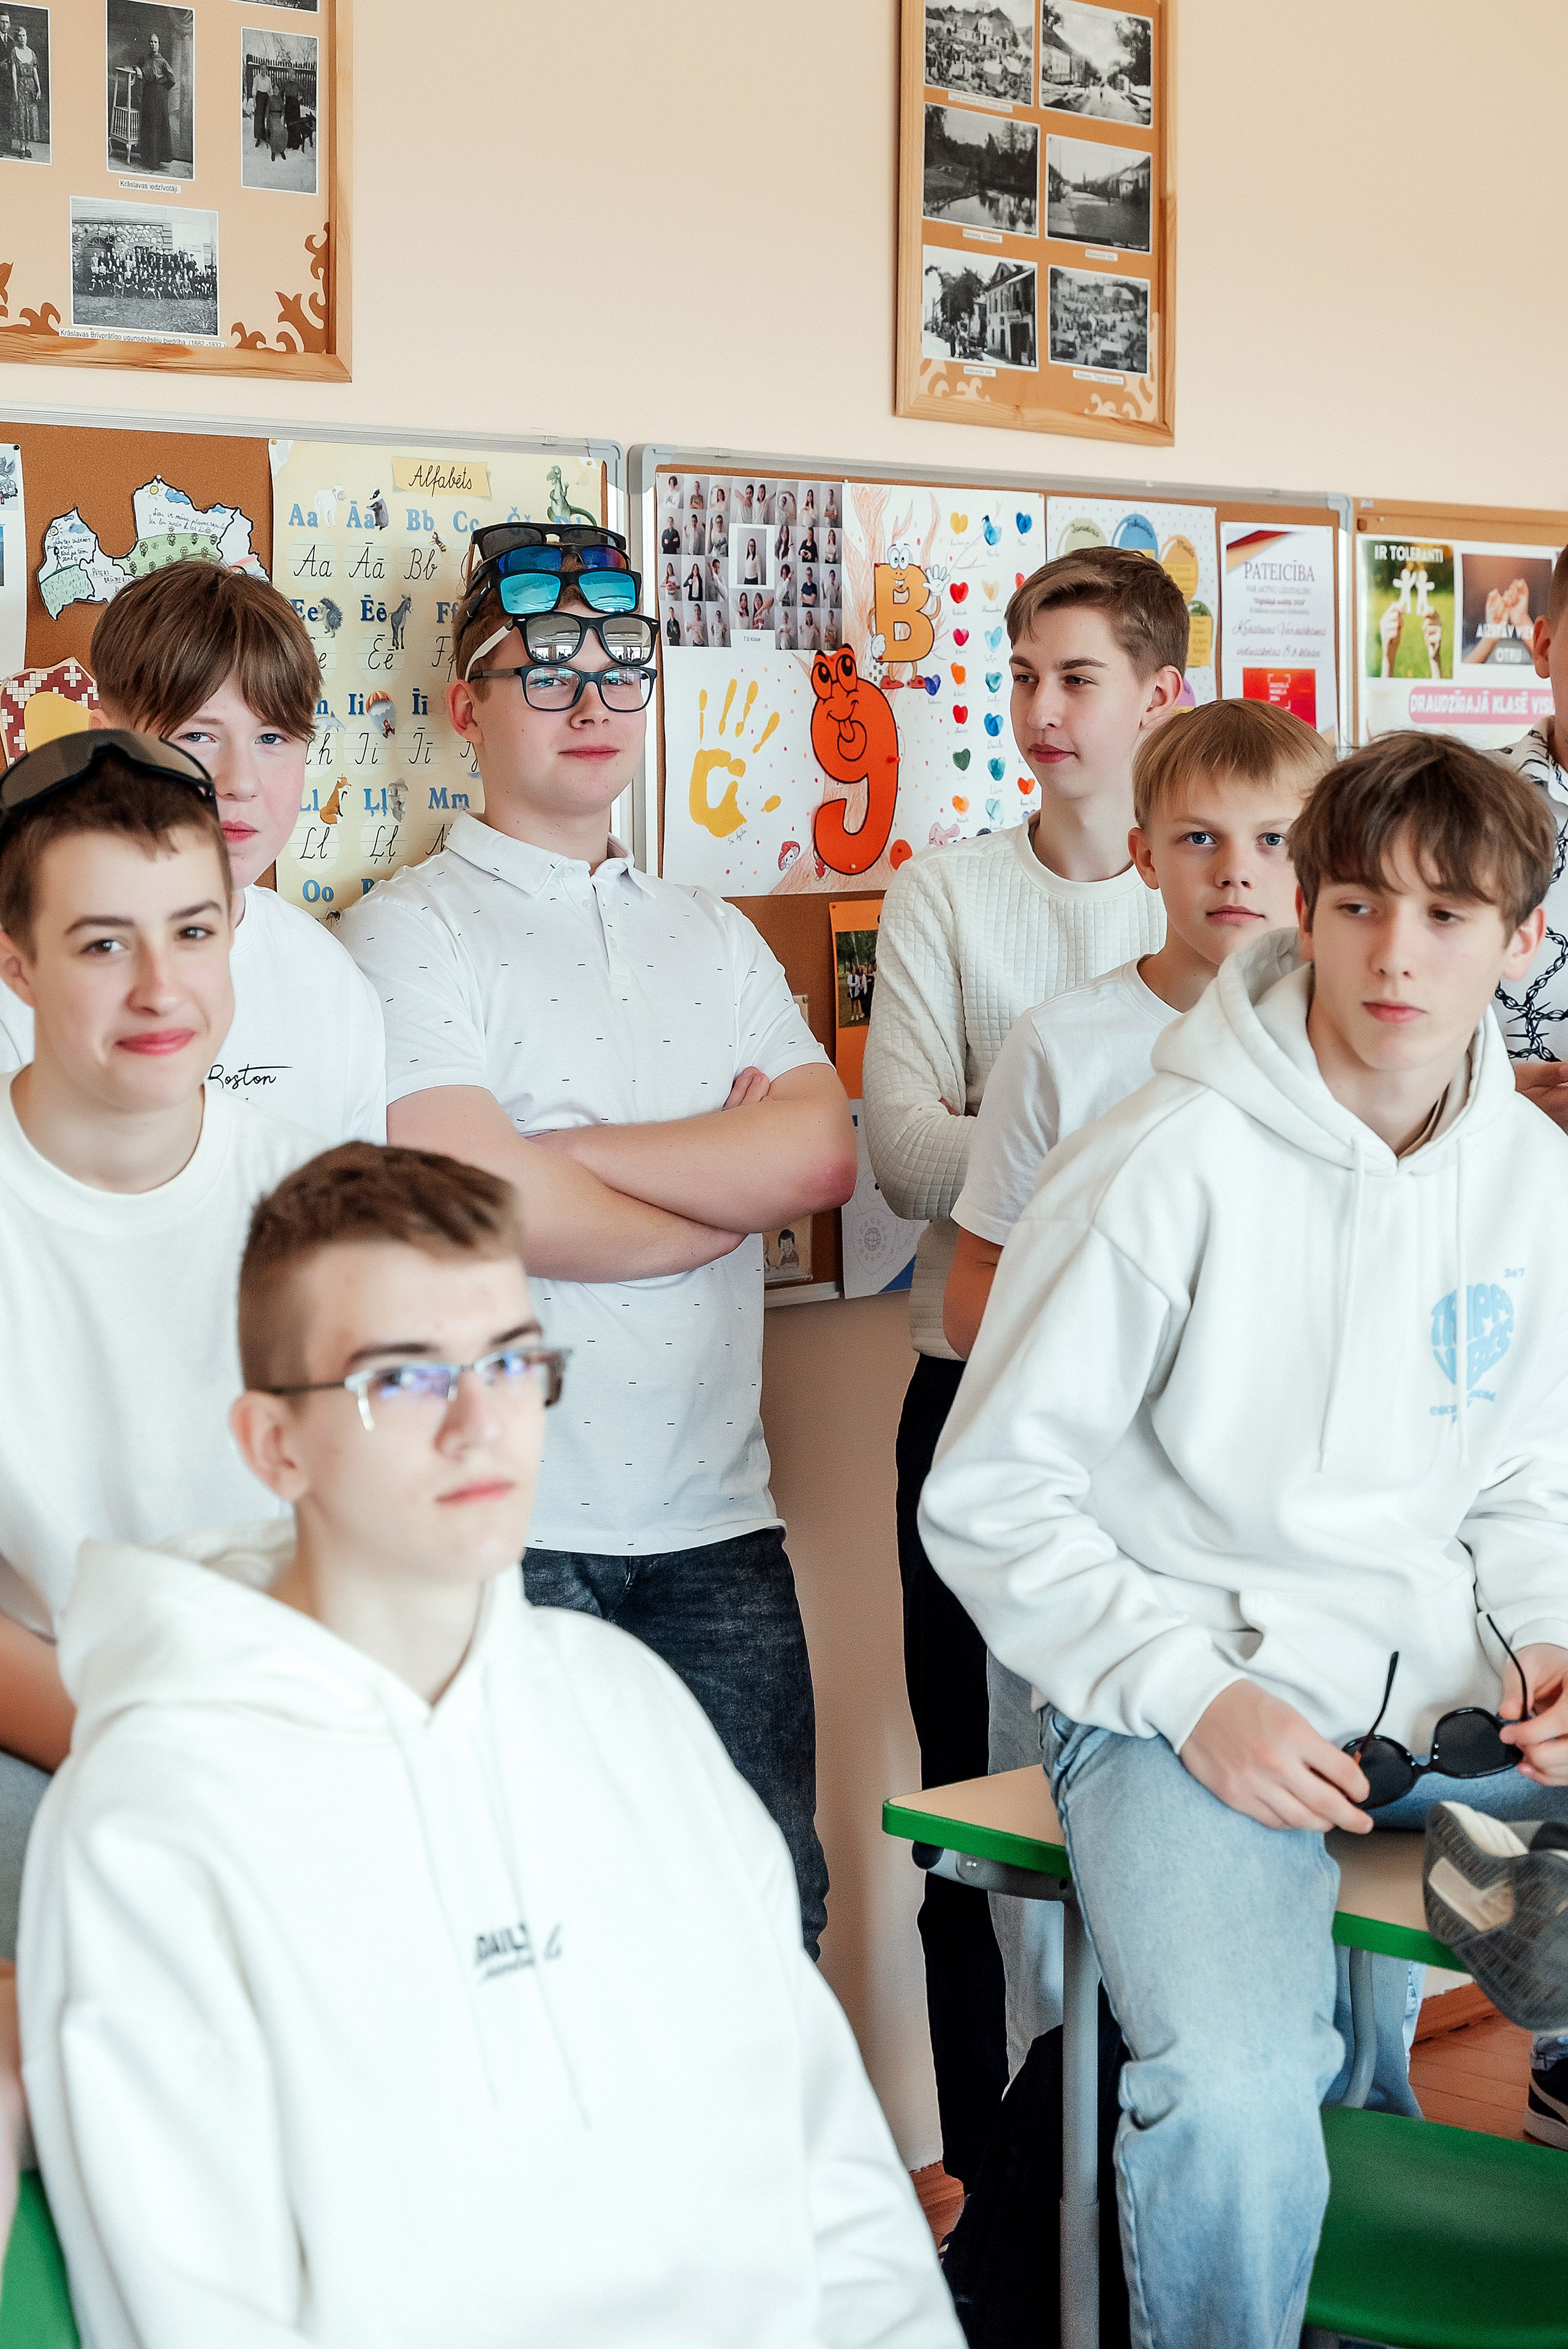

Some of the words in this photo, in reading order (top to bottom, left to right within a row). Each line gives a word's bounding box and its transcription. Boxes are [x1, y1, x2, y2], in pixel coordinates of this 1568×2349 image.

[120, 180, 148, 189] Krāslavas
[149, 184, 178, 194] iedzīvotāji
[60, 329, 89, 338] Krāslavas
[91, 331, 121, 340] Brīvprātīgo
[409, 465, 472, 497] Alfabēts
[288, 504, 318, 528] Aa
[406, 508, 434, 532] Bb
[453, 510, 480, 533] Cc
[293, 544, 332, 577] Aa
[349, 542, 385, 579] Āā
[404, 548, 437, 580] Bb
[1374, 545, 1388, 561] IR
[1389, 545, 1444, 564] TOLERANTI
[1244, 559, 1316, 583] PATEICĪBA
[360, 594, 387, 622] Ēē
[368, 634, 394, 670] Ēē
[349, 693, 364, 716] Ii
[412, 688, 428, 716] Īī
[1410, 690, 1490, 714] DRAUDZĪGAJĀ
[1492, 691, 1528, 714] KLASĒ
[355, 733, 379, 765] Ii
[409, 727, 434, 764] Īī
[364, 789, 388, 817] Ļļ
[428, 787, 470, 809] Mm
[300, 827, 328, 859] Ll
[369, 825, 399, 864] Ļļ
[302, 879, 334, 903] Oo
